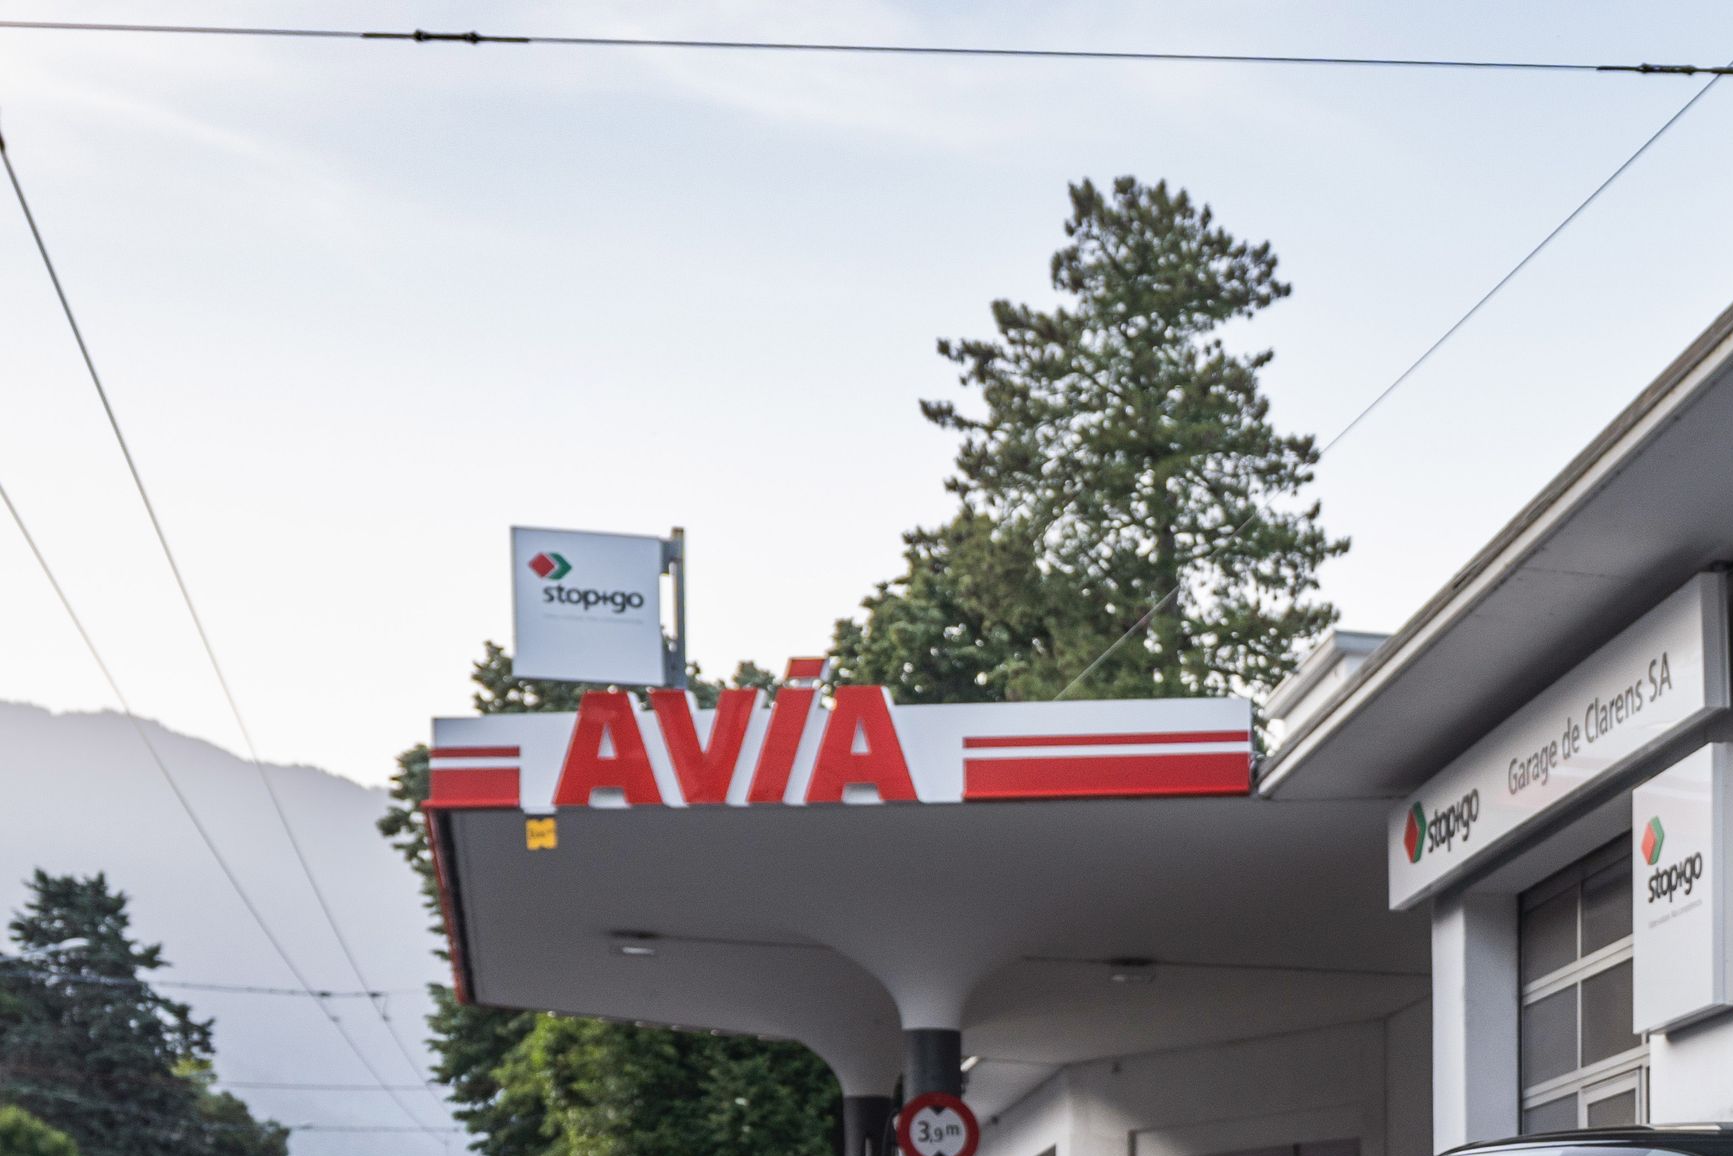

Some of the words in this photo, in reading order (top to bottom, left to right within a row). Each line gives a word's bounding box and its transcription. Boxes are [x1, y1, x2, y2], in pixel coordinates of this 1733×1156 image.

[543, 584, 644, 613] stop+go
[552, 657, 919, 806] AVIA
[1427, 788, 1480, 854] stop+go
[1507, 738, 1557, 796] Garage
[1562, 716, 1580, 761] de
[1585, 678, 1643, 744] Clarens
[1649, 651, 1673, 703] SA
[1648, 852, 1703, 904] stop+go
